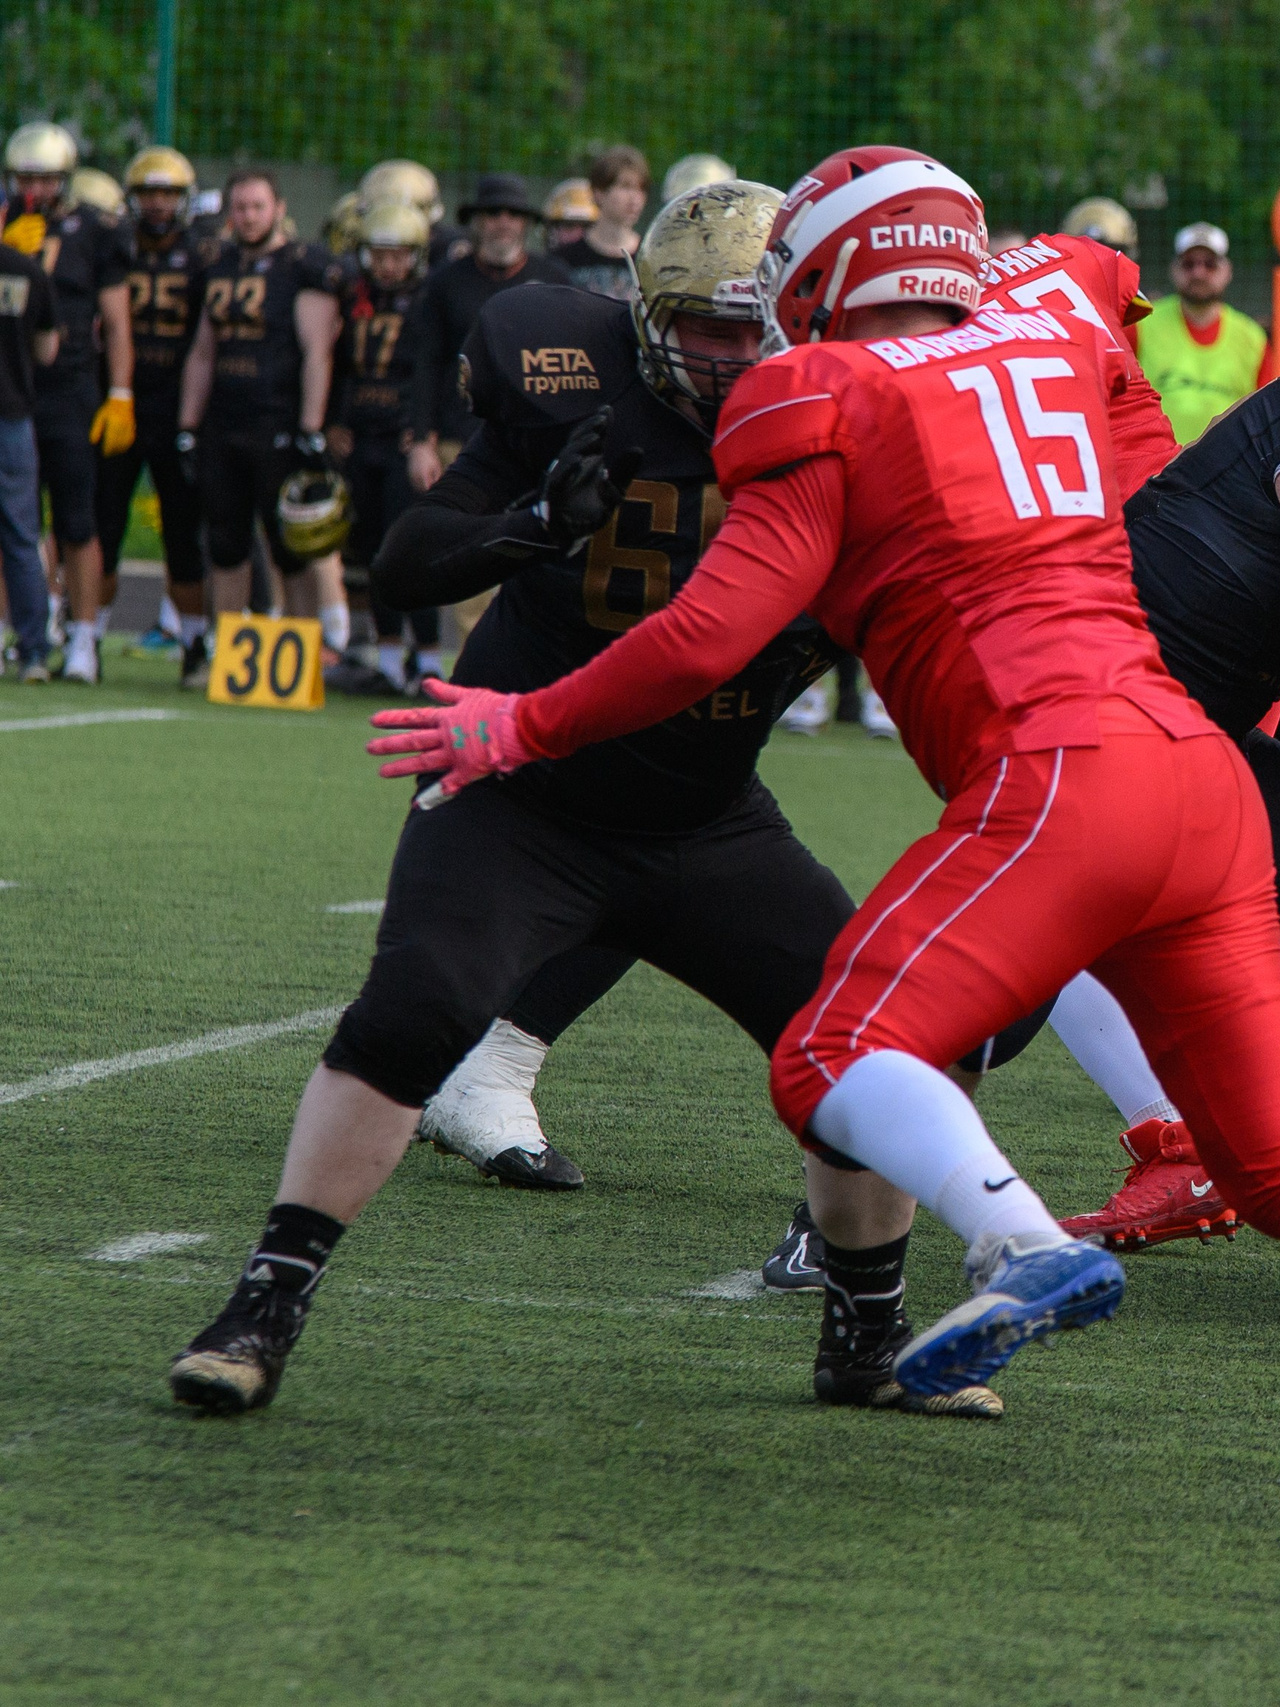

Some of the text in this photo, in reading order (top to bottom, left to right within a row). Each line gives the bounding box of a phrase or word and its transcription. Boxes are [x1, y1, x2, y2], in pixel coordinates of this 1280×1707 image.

[898, 275, 980, 305] Riddell
[354, 313, 403, 377] 17
[521, 347, 596, 374] МЕТА
[523, 375, 600, 395] группа
[946, 356, 1106, 520] 15
[227, 628, 304, 698] 30
